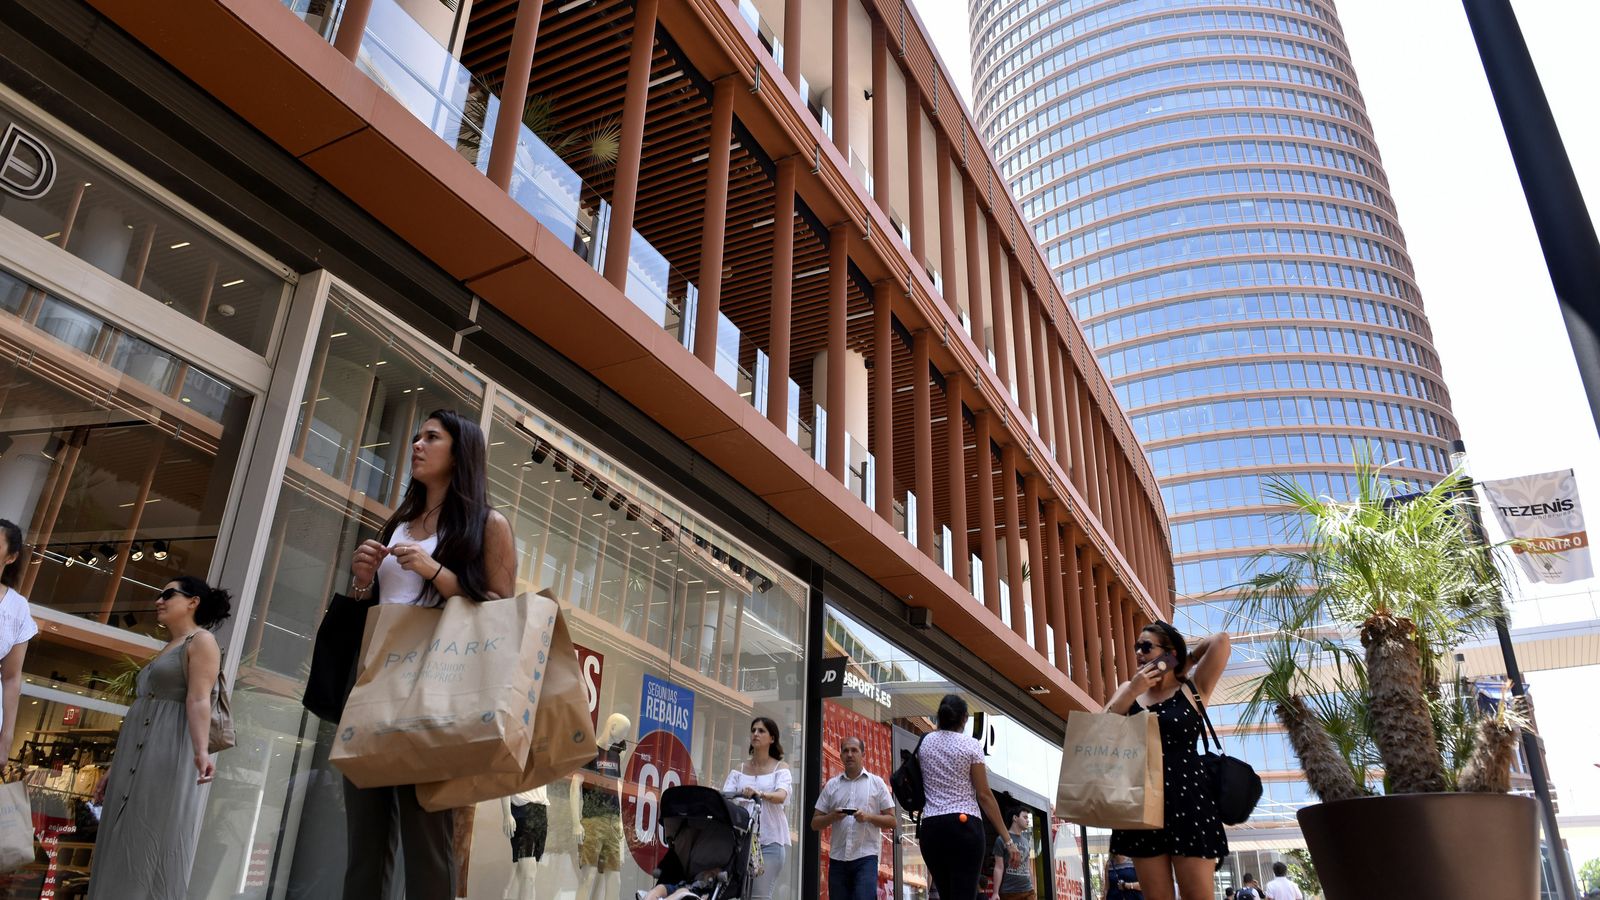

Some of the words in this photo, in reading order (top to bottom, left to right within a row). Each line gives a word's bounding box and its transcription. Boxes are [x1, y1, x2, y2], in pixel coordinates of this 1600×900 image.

[383, 638, 499, 669] PRMARK
[821, 669, 837, 683] JD
[647, 681, 678, 705] SEGUNDAS
[645, 695, 689, 730] REBAJAS
[1073, 744, 1139, 761] PRIMARK
